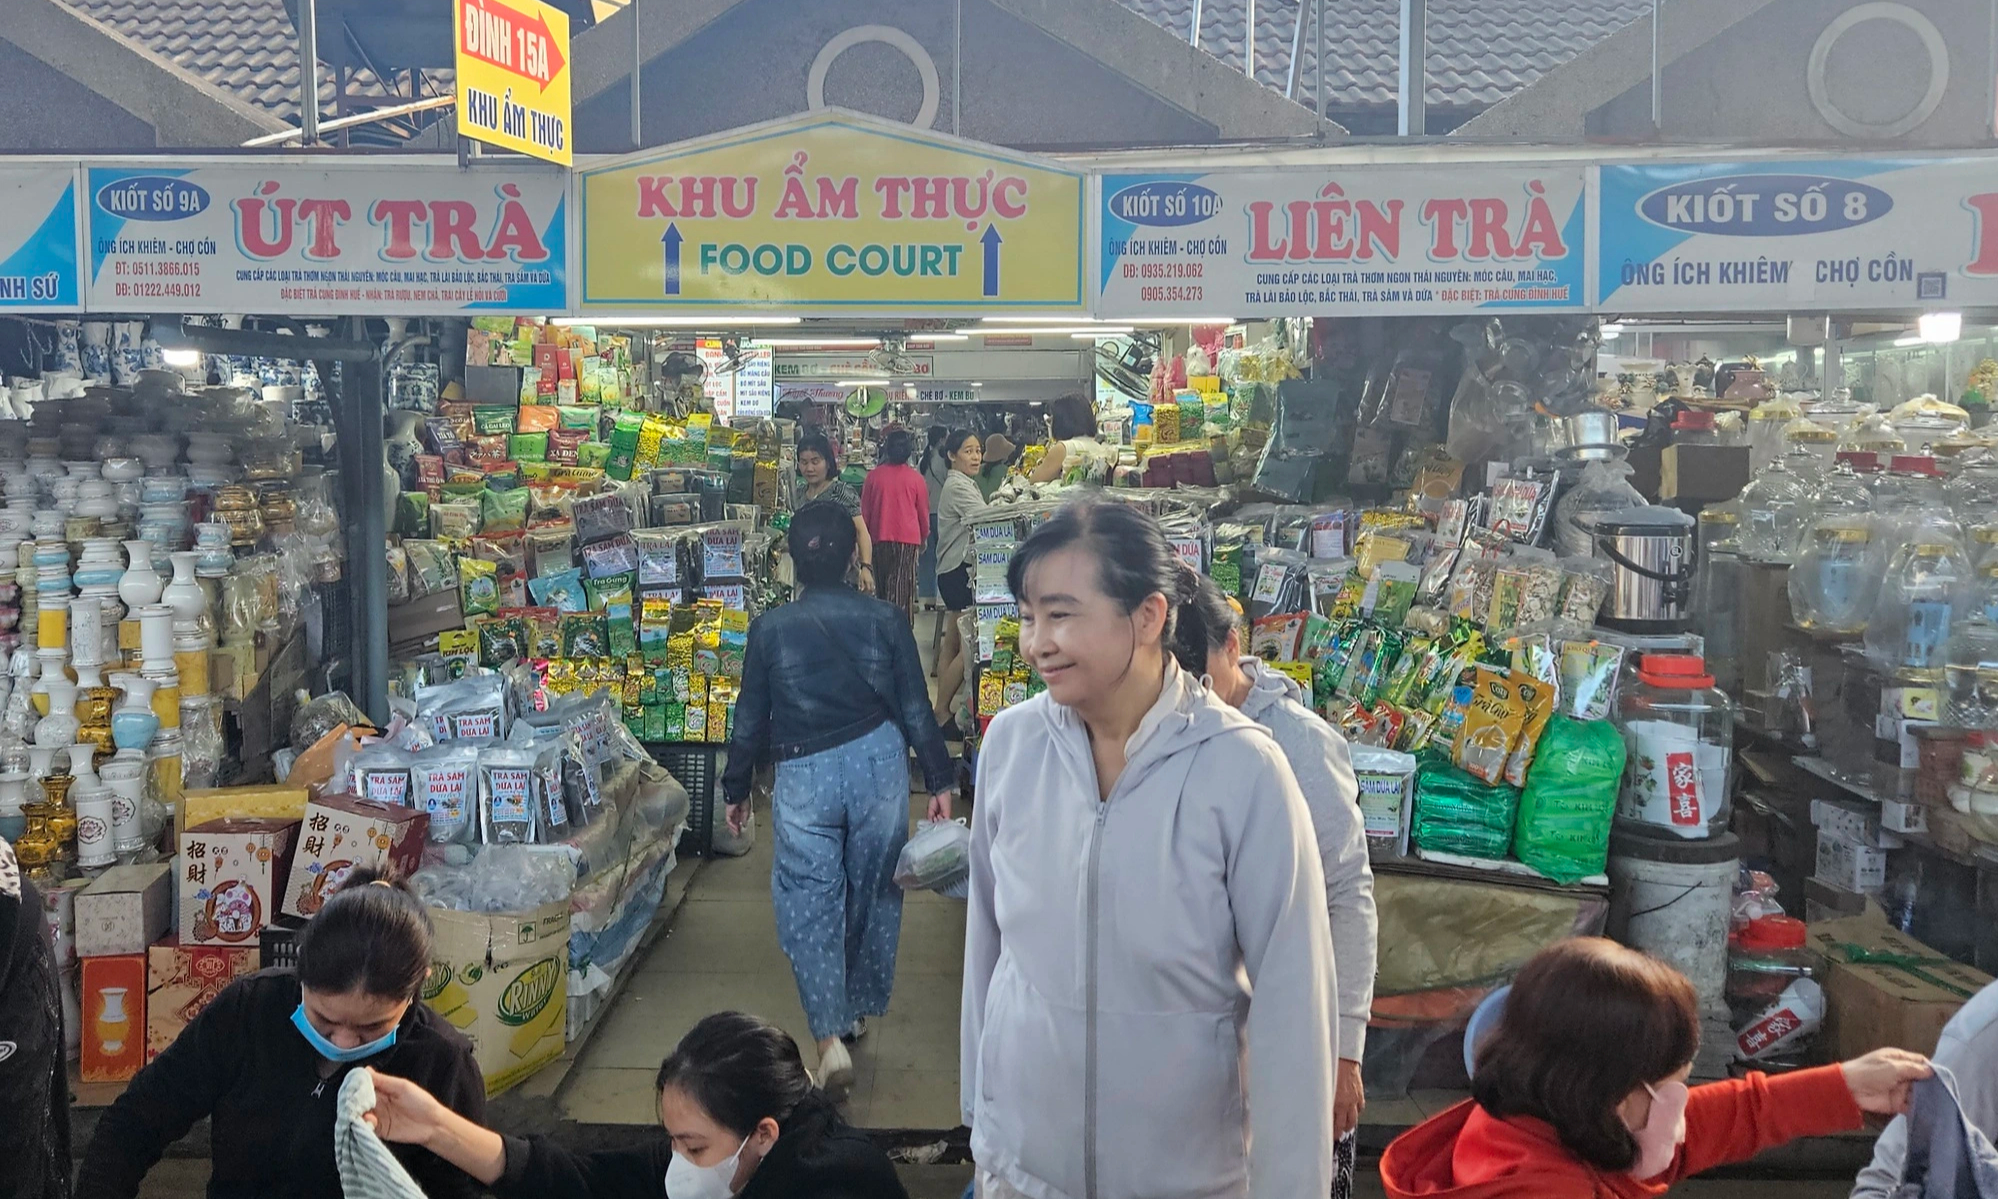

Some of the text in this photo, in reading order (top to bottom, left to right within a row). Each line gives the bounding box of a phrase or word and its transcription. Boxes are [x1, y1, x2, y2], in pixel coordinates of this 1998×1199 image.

[465, 0, 549, 82] ĐÌNH 15A
[468, 88, 563, 154] KHU ẨM THỰC
[110, 182, 200, 212] KIỐT SỐ 9A
[636, 150, 1028, 231] KHU ẨM THỰC
[1123, 187, 1223, 217] KIỐT SỐ 10A
[1666, 182, 1867, 223] KIỐT SỐ 8
[232, 180, 550, 263] ÚT TRÀ
[1246, 179, 1568, 264] LIÊN TRÀ
[98, 237, 116, 254] ÔNG
[119, 237, 135, 254] ÍCH
[137, 237, 166, 254] KHIÊM
[176, 240, 195, 257] CHỢ
[197, 236, 216, 255] CỒN
[701, 243, 963, 277] FOOD COURT
[1109, 237, 1127, 255] ÔNG
[1130, 238, 1145, 255] ÍCH
[1148, 237, 1177, 255] KHIÊM
[1187, 239, 1206, 258] CHỢ
[1208, 234, 1227, 255] CỒN
[115, 261, 200, 276] ĐT: 0511.3866.015
[236, 270, 251, 281] CUNG
[1123, 263, 1203, 278] DĐ: 0935.219.062
[1257, 270, 1557, 286] CUNG CẤP CÁC LOẠI TRÀ THƠM NGON THÁI NGUYÊN: MÓC CÂU, MAI HẠC,
[1621, 251, 1914, 287] ÔNG ÍCH KHIÊM CHỢ CỒN
[33, 272, 58, 299] SỨ
[115, 283, 201, 297] DĐ: 01222.449.012
[1141, 286, 1203, 301] 0905.354.273
[1245, 291, 1260, 303] TRÀ
[1264, 291, 1276, 303] LÀI
[1279, 288, 1295, 303] BẢO
[1299, 290, 1317, 305] LỘC,
[1319, 287, 1336, 302] BẮC
[1338, 290, 1360, 303] THÁI,
[1362, 289, 1378, 302] TRÀ
[1380, 290, 1400, 302] SÂM
[1403, 290, 1413, 301] VÀ
[1441, 289, 1459, 303] ĐẶC
[1461, 288, 1482, 303] BIỆT:
[1484, 288, 1500, 300] TRÀ
[1502, 289, 1526, 300] CUNG
[1528, 285, 1548, 299] ĐÌNH
[1551, 284, 1569, 299] HUẾ
[775, 364, 799, 375] KEM
[1182, 541, 1200, 556] DỨA
[302, 812, 330, 858] 招財
[186, 840, 208, 885] 招財
[509, 957, 558, 1017] RINNY
